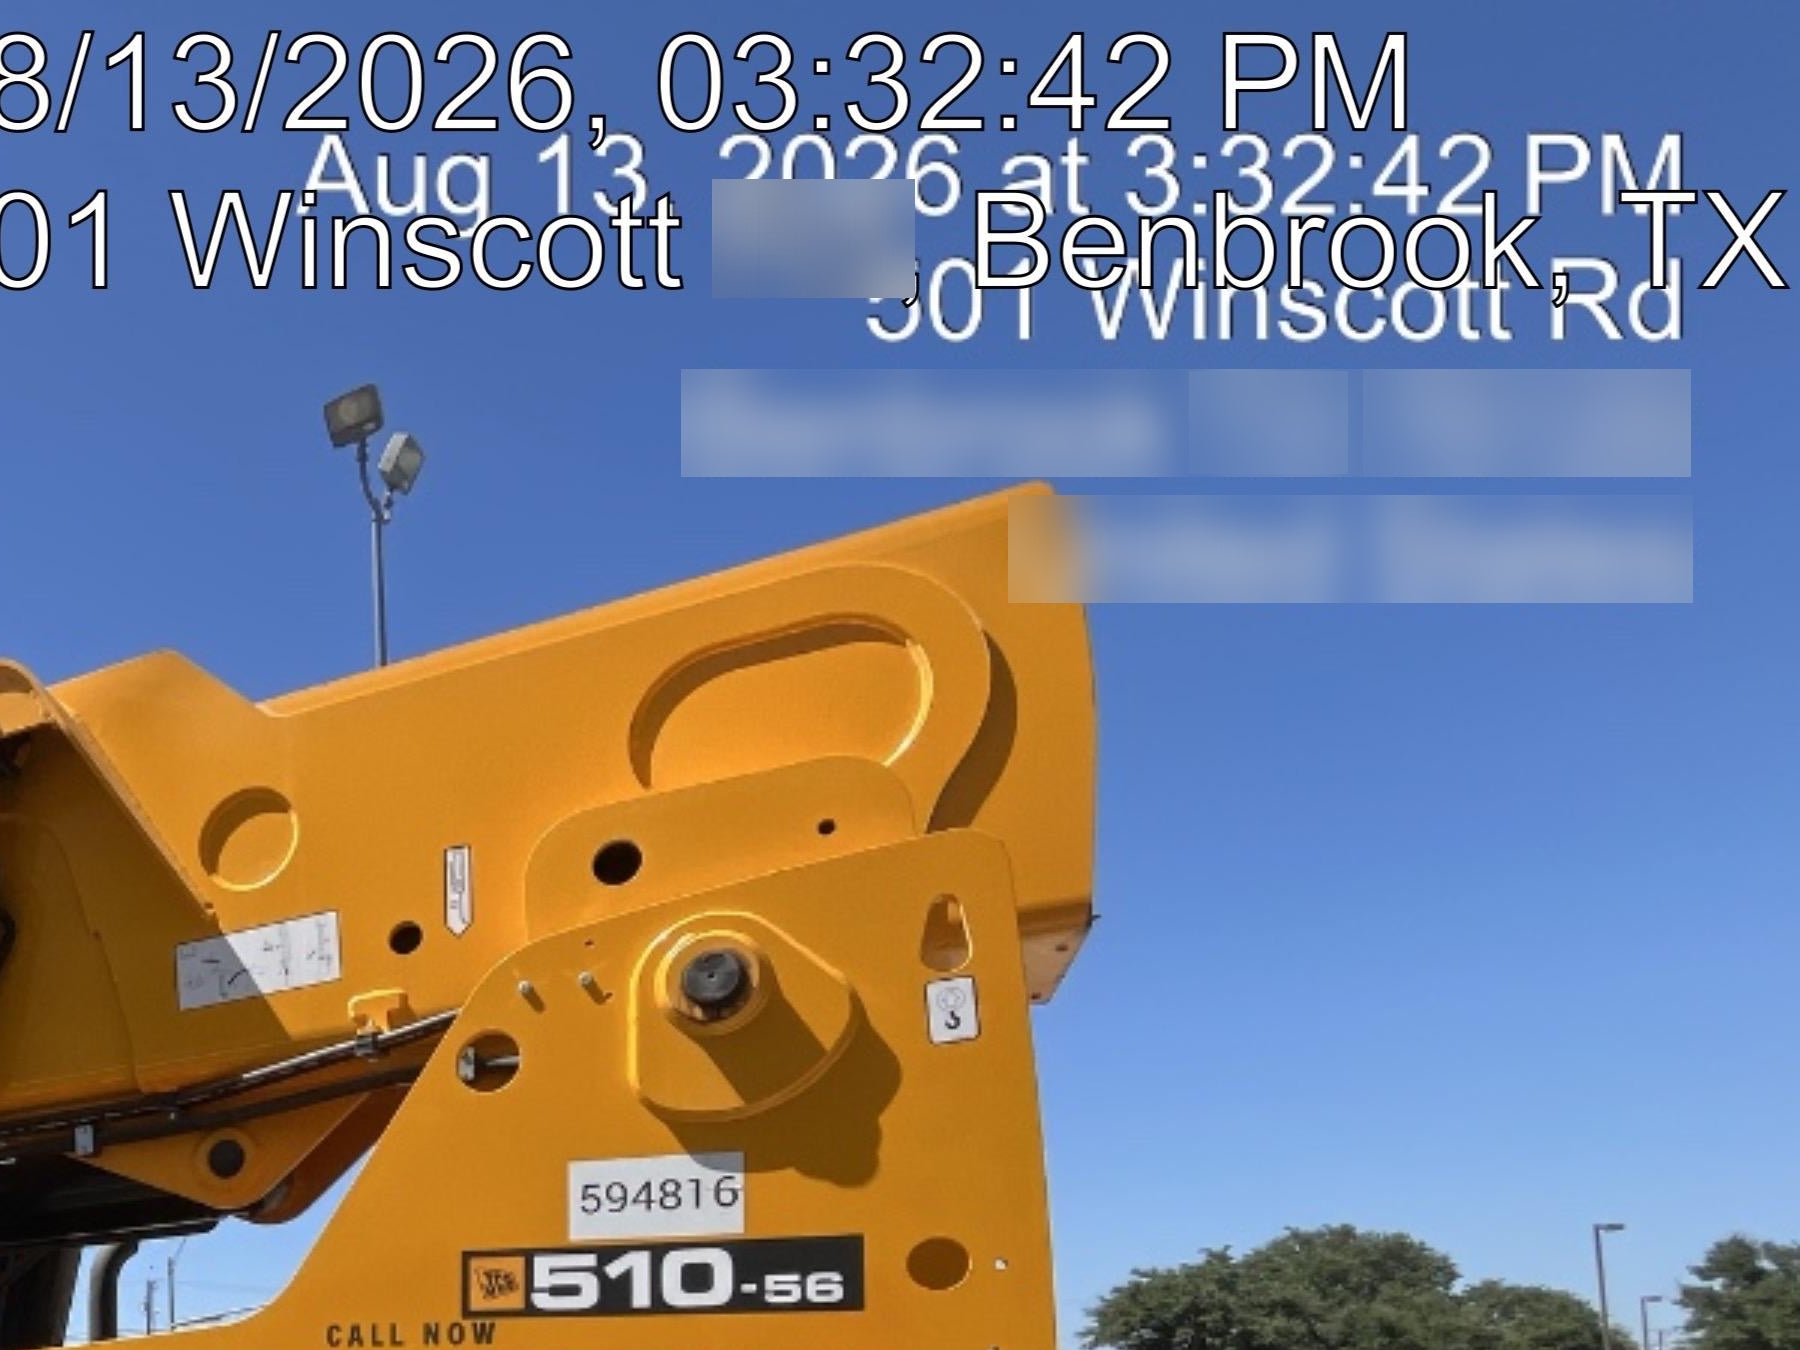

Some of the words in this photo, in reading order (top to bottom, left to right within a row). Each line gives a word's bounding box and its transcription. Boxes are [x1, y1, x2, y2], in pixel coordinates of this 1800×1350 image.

[580, 1174, 741, 1216] 594816
[325, 1323, 404, 1348] CALL
[423, 1321, 497, 1346] NOW
